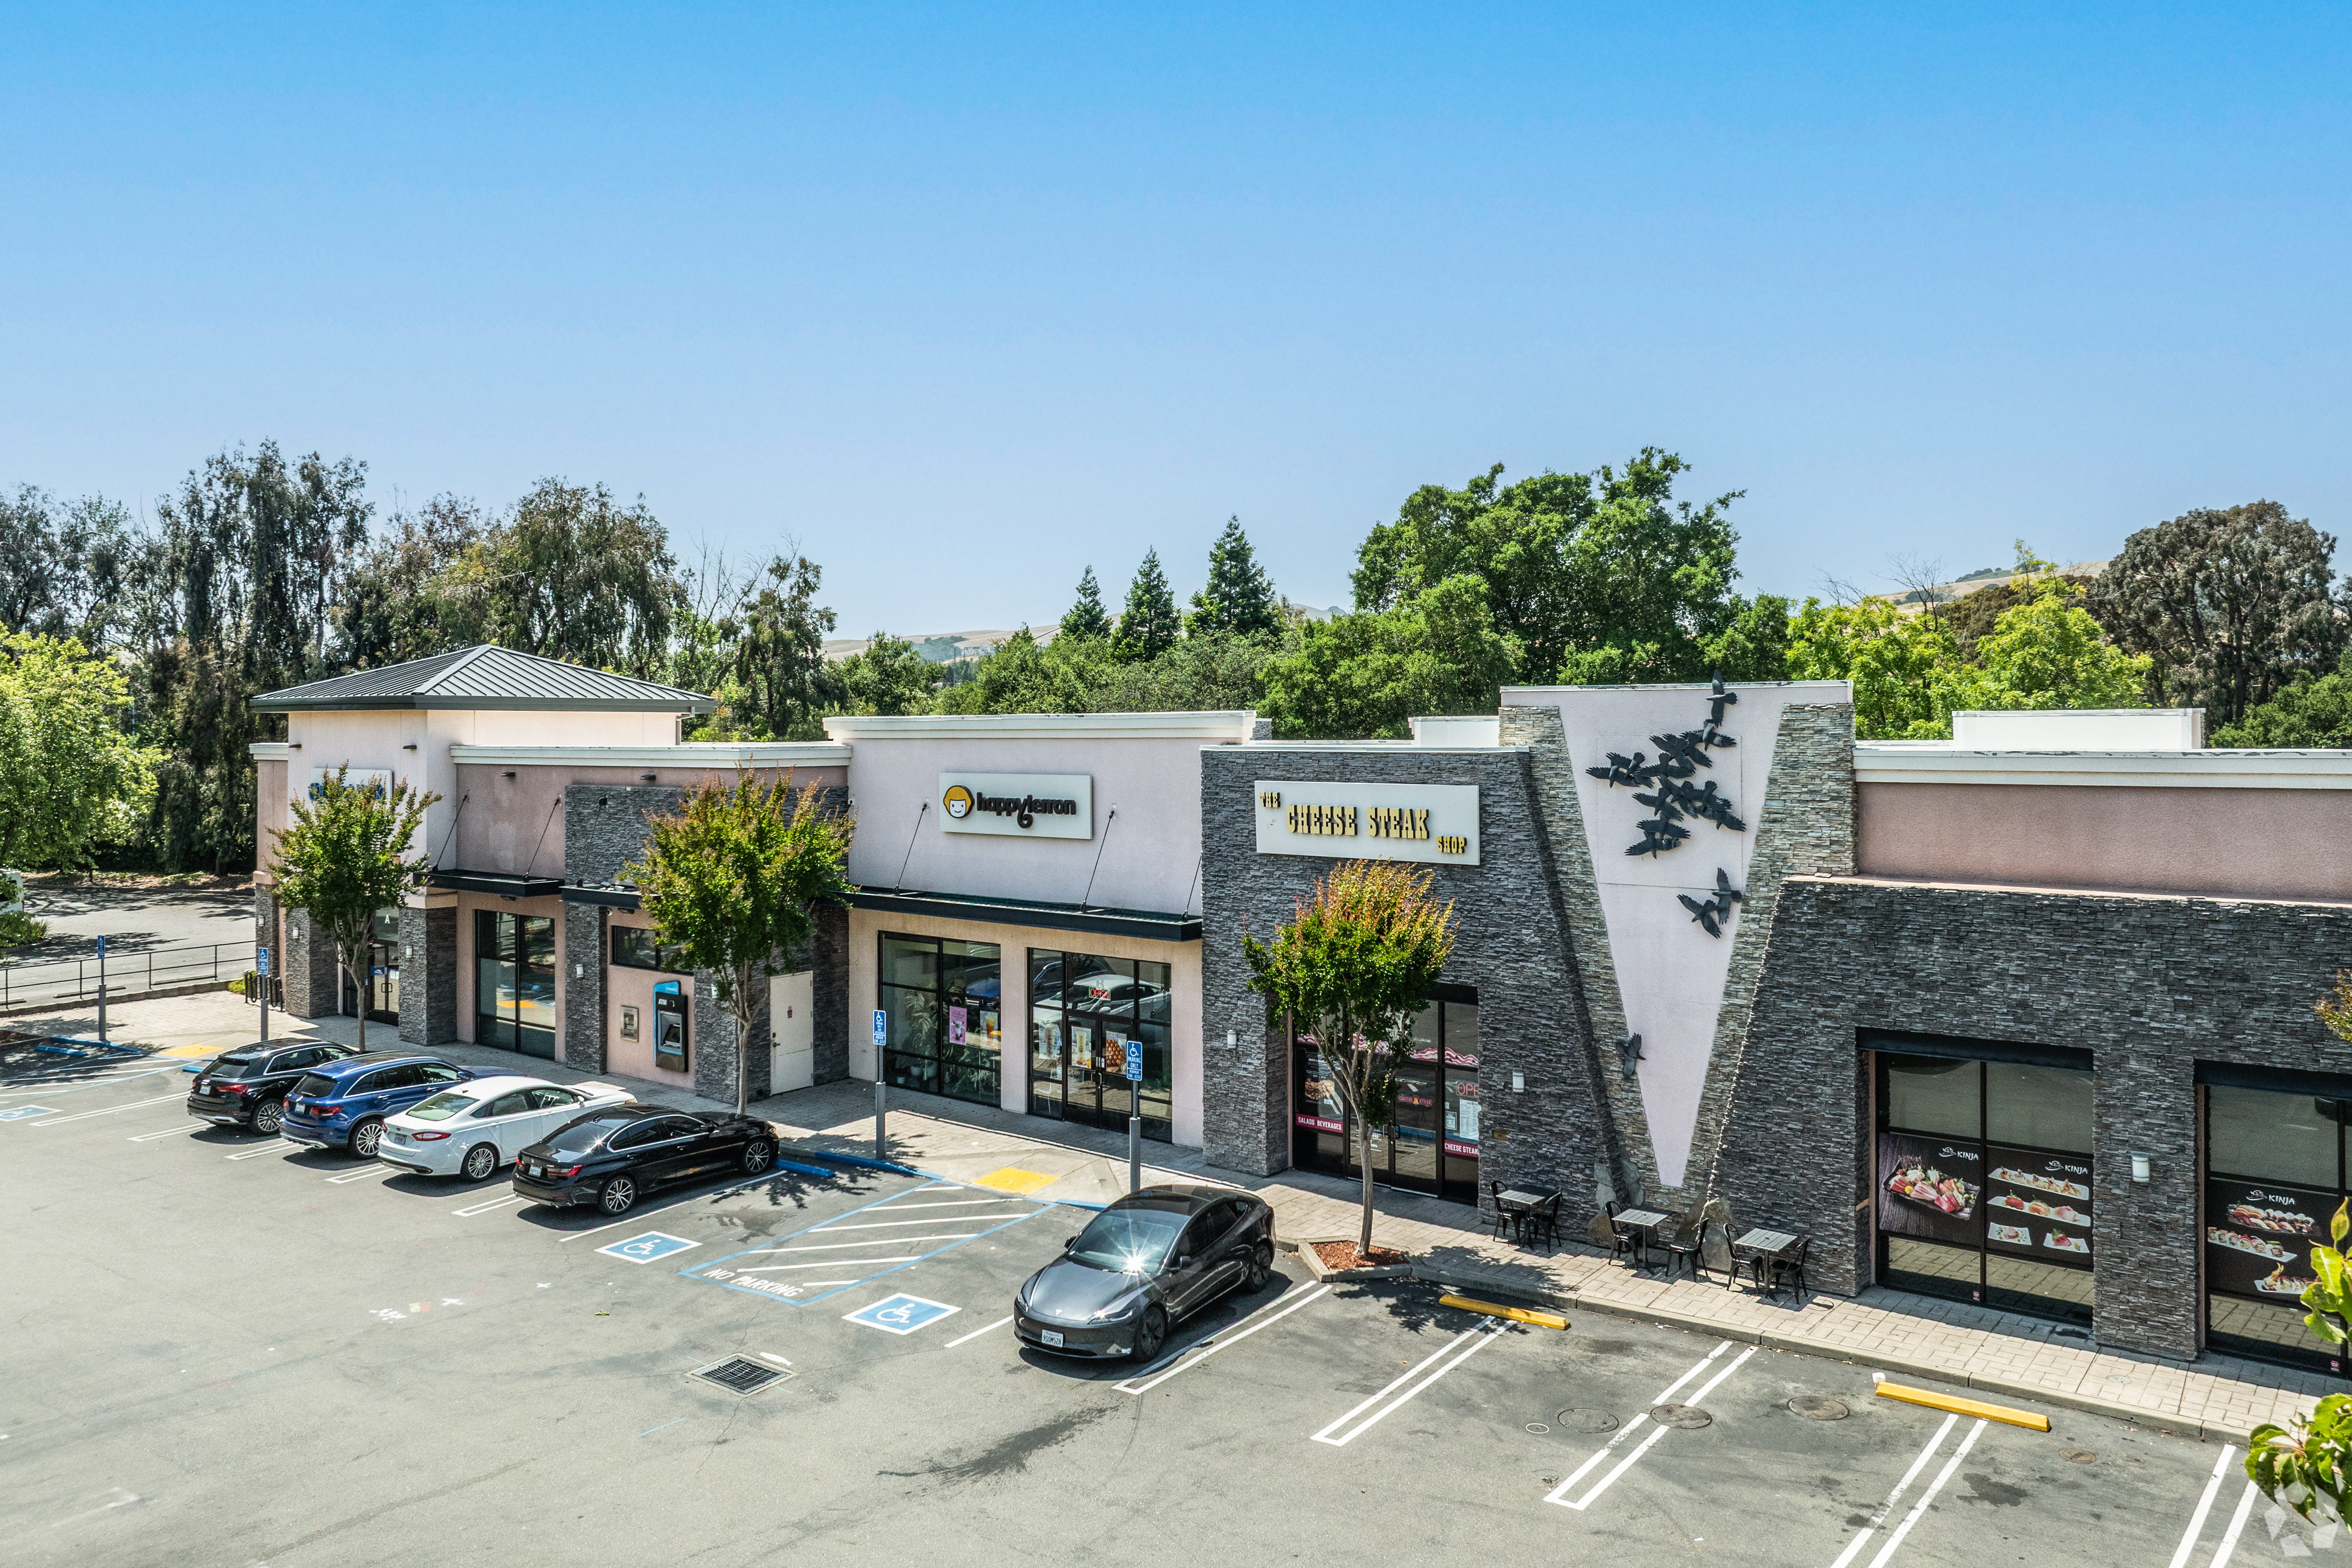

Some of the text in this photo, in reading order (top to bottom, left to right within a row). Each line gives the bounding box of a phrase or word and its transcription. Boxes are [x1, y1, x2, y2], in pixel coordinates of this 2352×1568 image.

[1260, 792, 1280, 808] THE
[1287, 804, 1430, 839] CHEESE STEAK
[1437, 836, 1467, 853] SHOP
[385, 914, 390, 924] A
[1096, 978, 1104, 989] B
[1090, 988, 1109, 999] OPEN
[1457, 1082, 1478, 1098] OPE
[1298, 1117, 1342, 1130] SALADS BEVERAGES
[1445, 1143, 1462, 1152] CHEESE
[1957, 1151, 1979, 1161] KINJA
[2065, 1164, 2088, 1174] KINJA
[2269, 1194, 2295, 1205] KINJA
[703, 1268, 804, 1297] NO PARKING
